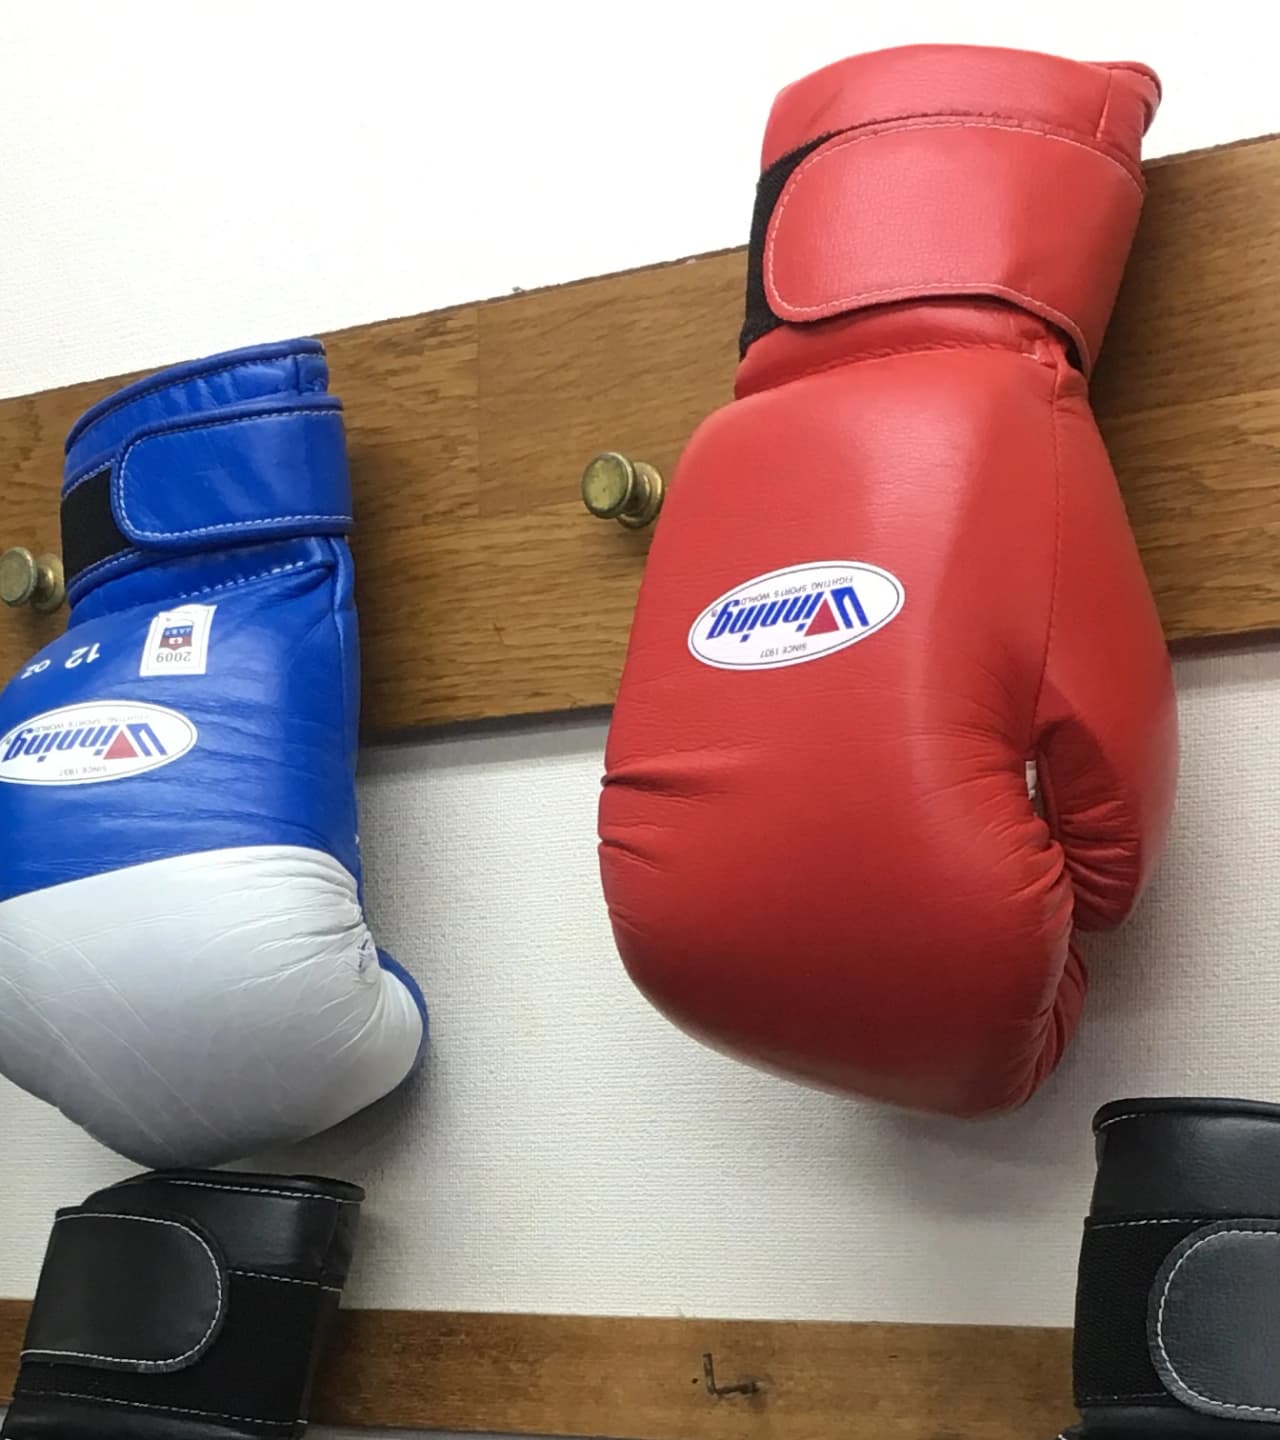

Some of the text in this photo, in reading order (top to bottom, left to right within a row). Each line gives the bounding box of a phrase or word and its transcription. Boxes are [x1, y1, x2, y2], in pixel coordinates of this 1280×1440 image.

[739, 576, 854, 607] FIGHTING SPORTS WORLD
[705, 586, 870, 643] Winning
[64, 642, 101, 669] 12
[156, 651, 192, 663] 2009
[760, 642, 808, 659] SINCE 1937
[2, 722, 169, 763] Winning
